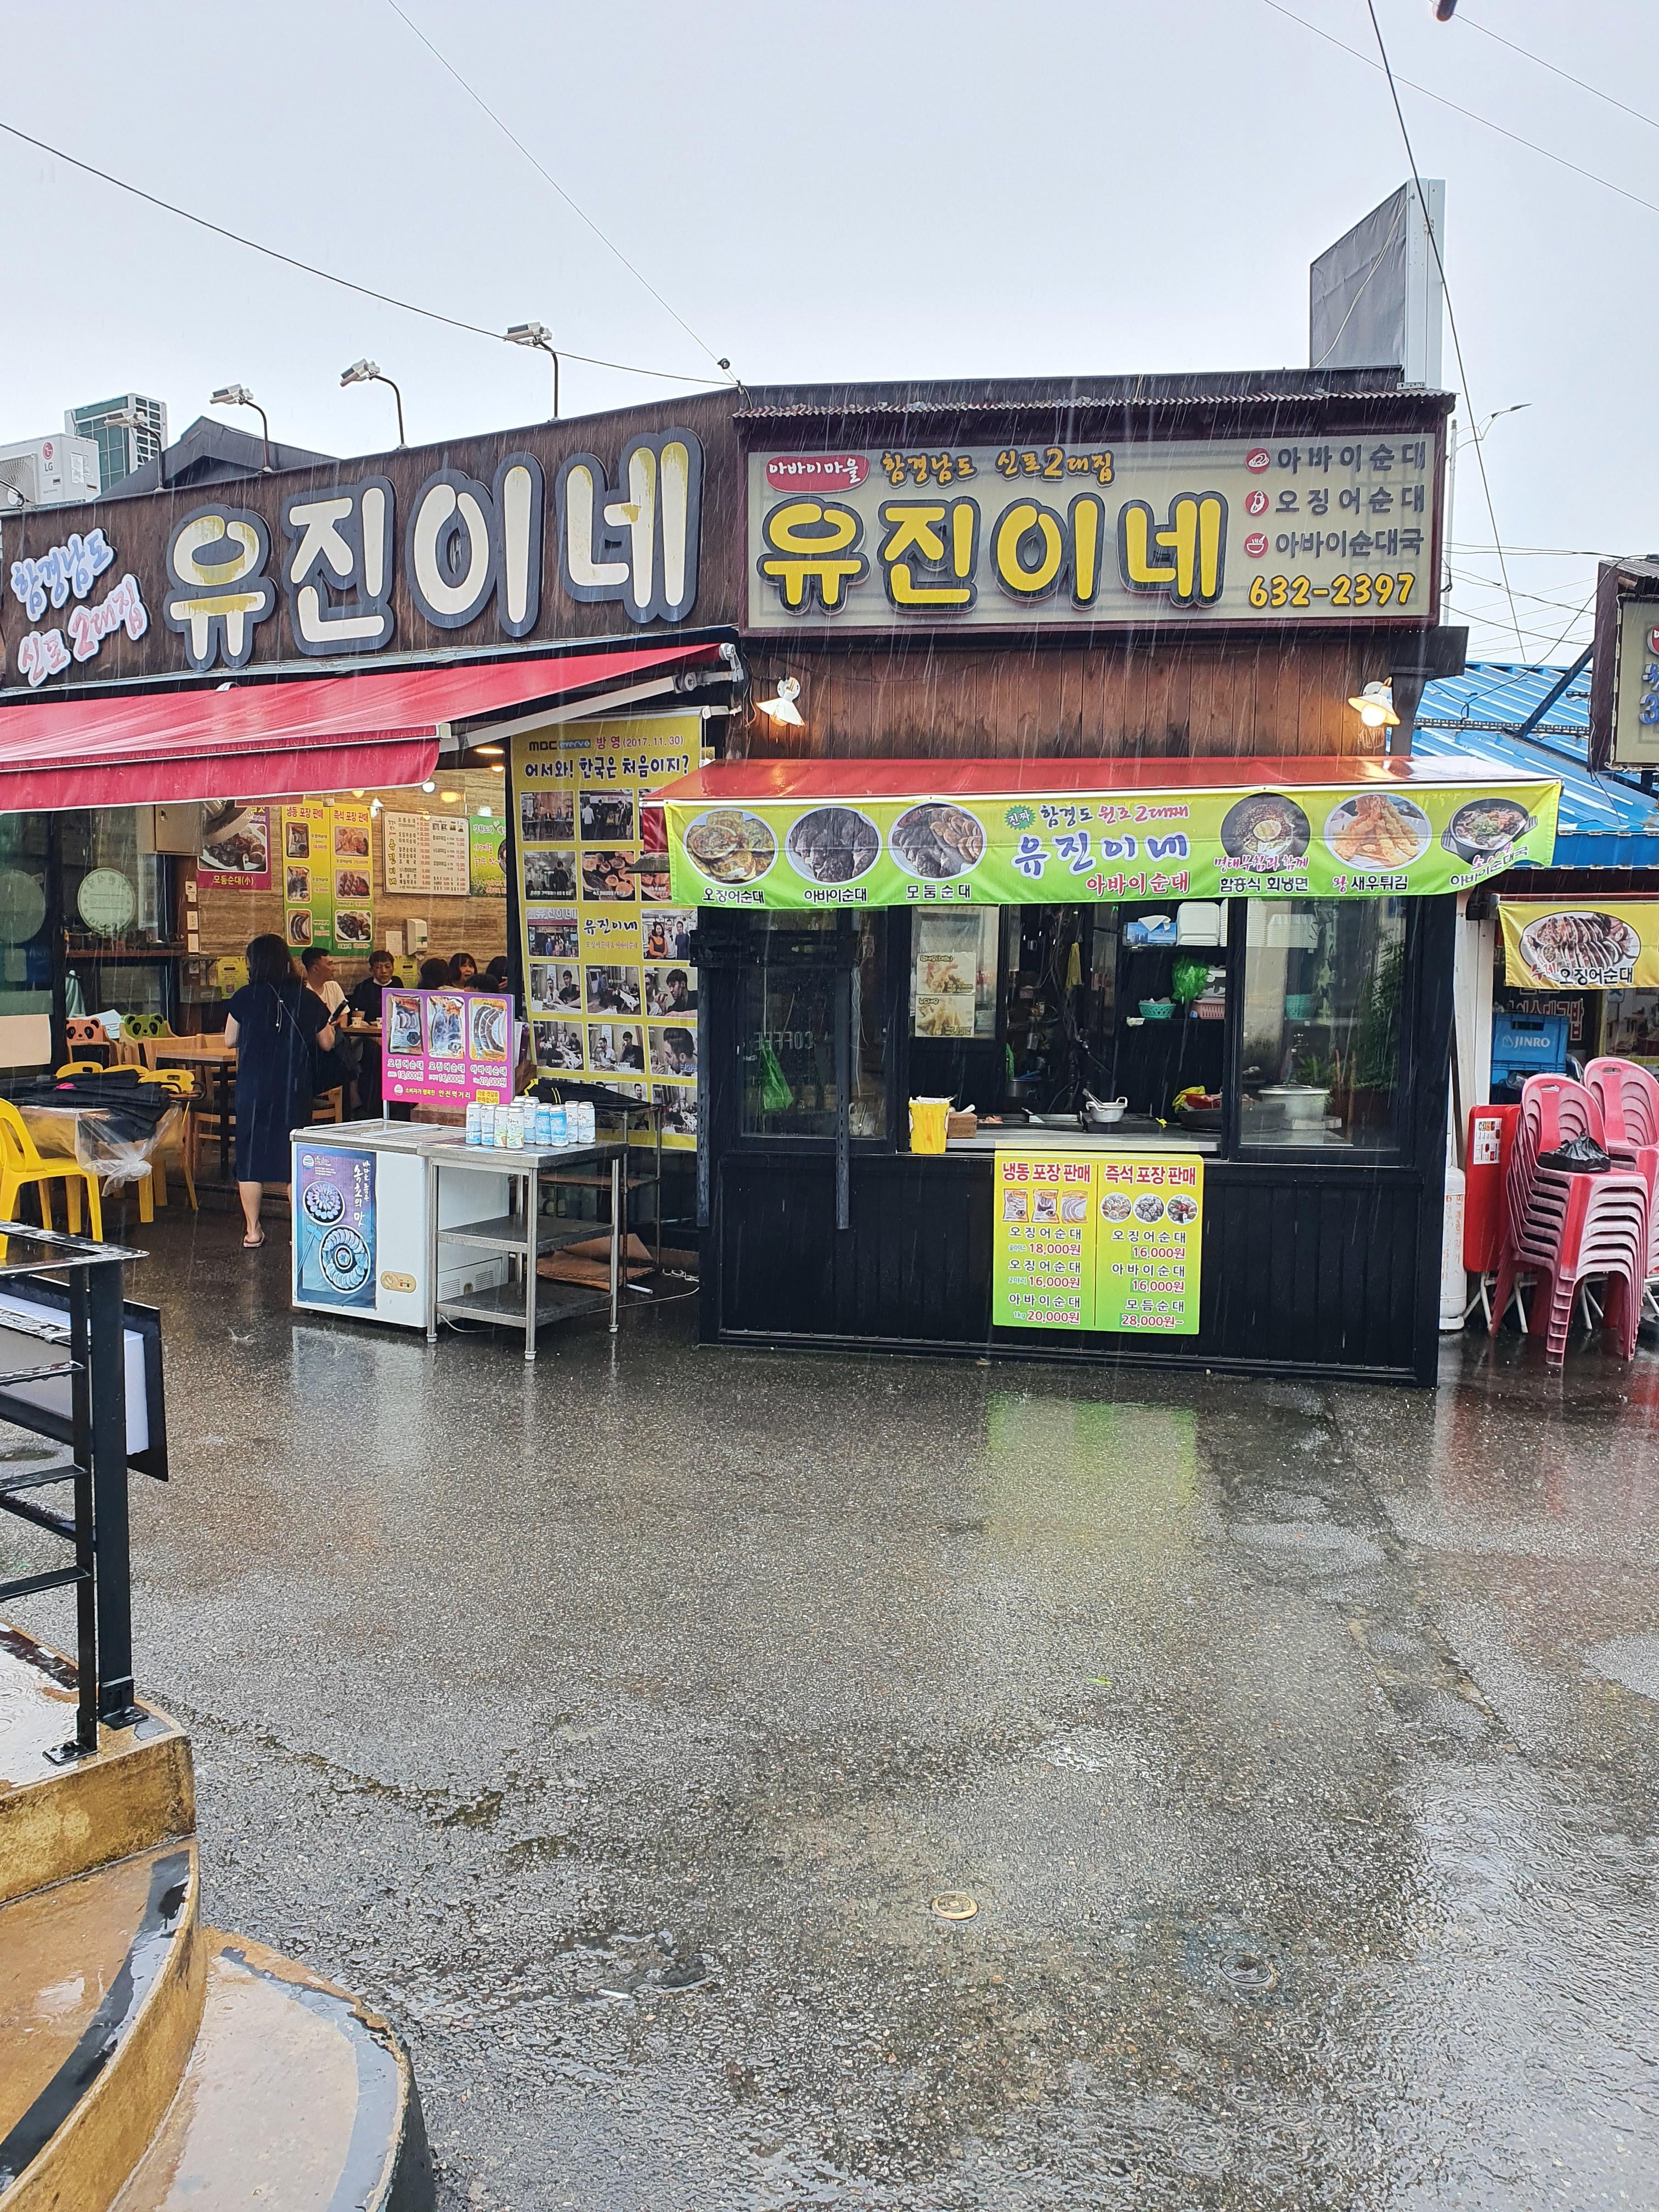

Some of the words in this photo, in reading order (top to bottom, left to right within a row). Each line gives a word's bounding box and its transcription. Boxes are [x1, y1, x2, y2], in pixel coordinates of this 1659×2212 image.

[1278, 441, 1426, 474] 아바이순대
[44, 462, 53, 471] LG
[769, 458, 861, 483] 아바이마을
[882, 451, 976, 486] 함경남도
[997, 450, 1041, 478] 신포
[1043, 448, 1114, 485] 2대집
[1276, 485, 1424, 516] 오징어순대
[168, 437, 692, 664] 유진이네
[1276, 528, 1424, 558] 아바이순대국
[763, 496, 1222, 607] 유진이네
[14, 529, 112, 617] 함경남도
[1249, 572, 1415, 610] 632-2397
[20, 631, 69, 684] 신포
[70, 577, 147, 658] 2대집
[529, 741, 557, 751] MBC
[525, 759, 573, 778] 어서와!
[579, 757, 617, 779] 한국은
[622, 754, 689, 778] 처음이지?
[1008, 810, 1032, 826] 진짜
[1041, 805, 1093, 827] 함경도
[1098, 806, 1131, 825] 원조
[1134, 804, 1188, 822] 2대째
[1014, 832, 1187, 876] 유진이네
[1214, 856, 1278, 872] 명태무침과
[1283, 855, 1308, 871] 함께
[906, 884, 970, 899] 모둠순대
[1087, 871, 1189, 896] 아바이순대
[1220, 877, 1261, 892] 함흥식
[1266, 876, 1308, 891] 회냉면
[1332, 877, 1348, 893] 왕
[1352, 876, 1408, 890] 새우튀김
[703, 888, 765, 905] 오징어순대
[804, 888, 867, 904] 아바이순대
[583, 918, 637, 935] 유진이네
[1532, 963, 1556, 980] 수제
[1559, 967, 1633, 985] 오징어순대
[1514, 1037, 1550, 1048] JINRO
[388, 1059, 424, 1070] 오징어순대
[428, 1062, 465, 1073] 오징어순대
[470, 1064, 507, 1076] 아바이순대
[398, 1071, 424, 1081] 18,000원
[439, 1074, 465, 1084] 16,000원
[481, 1077, 507, 1087] 20,000원
[1002, 1163, 1030, 1181] 냉동
[1032, 1164, 1060, 1182] 포장
[1064, 1164, 1091, 1183] 판매
[1105, 1165, 1133, 1184] 즉석
[1136, 1166, 1165, 1185] 포장
[1168, 1167, 1197, 1186] 판매
[354, 1211, 366, 1227] 맛
[1009, 1227, 1081, 1240] 오징어순대
[1112, 1231, 1186, 1243] 오징어순대
[1029, 1244, 1081, 1256] 18,000원
[1133, 1247, 1185, 1259] 16,000원
[1008, 1260, 1080, 1273] 오징어순대
[1112, 1264, 1184, 1277] 아바이순대
[1029, 1277, 1080, 1289] 16,000원
[1132, 1280, 1184, 1293] 16,000원
[1009, 1294, 1080, 1308] 아바이순대
[1126, 1300, 1184, 1312] 모듬순대
[1028, 1311, 1080, 1323] 20,000원
[1122, 1315, 1183, 1328] 28,000원~
